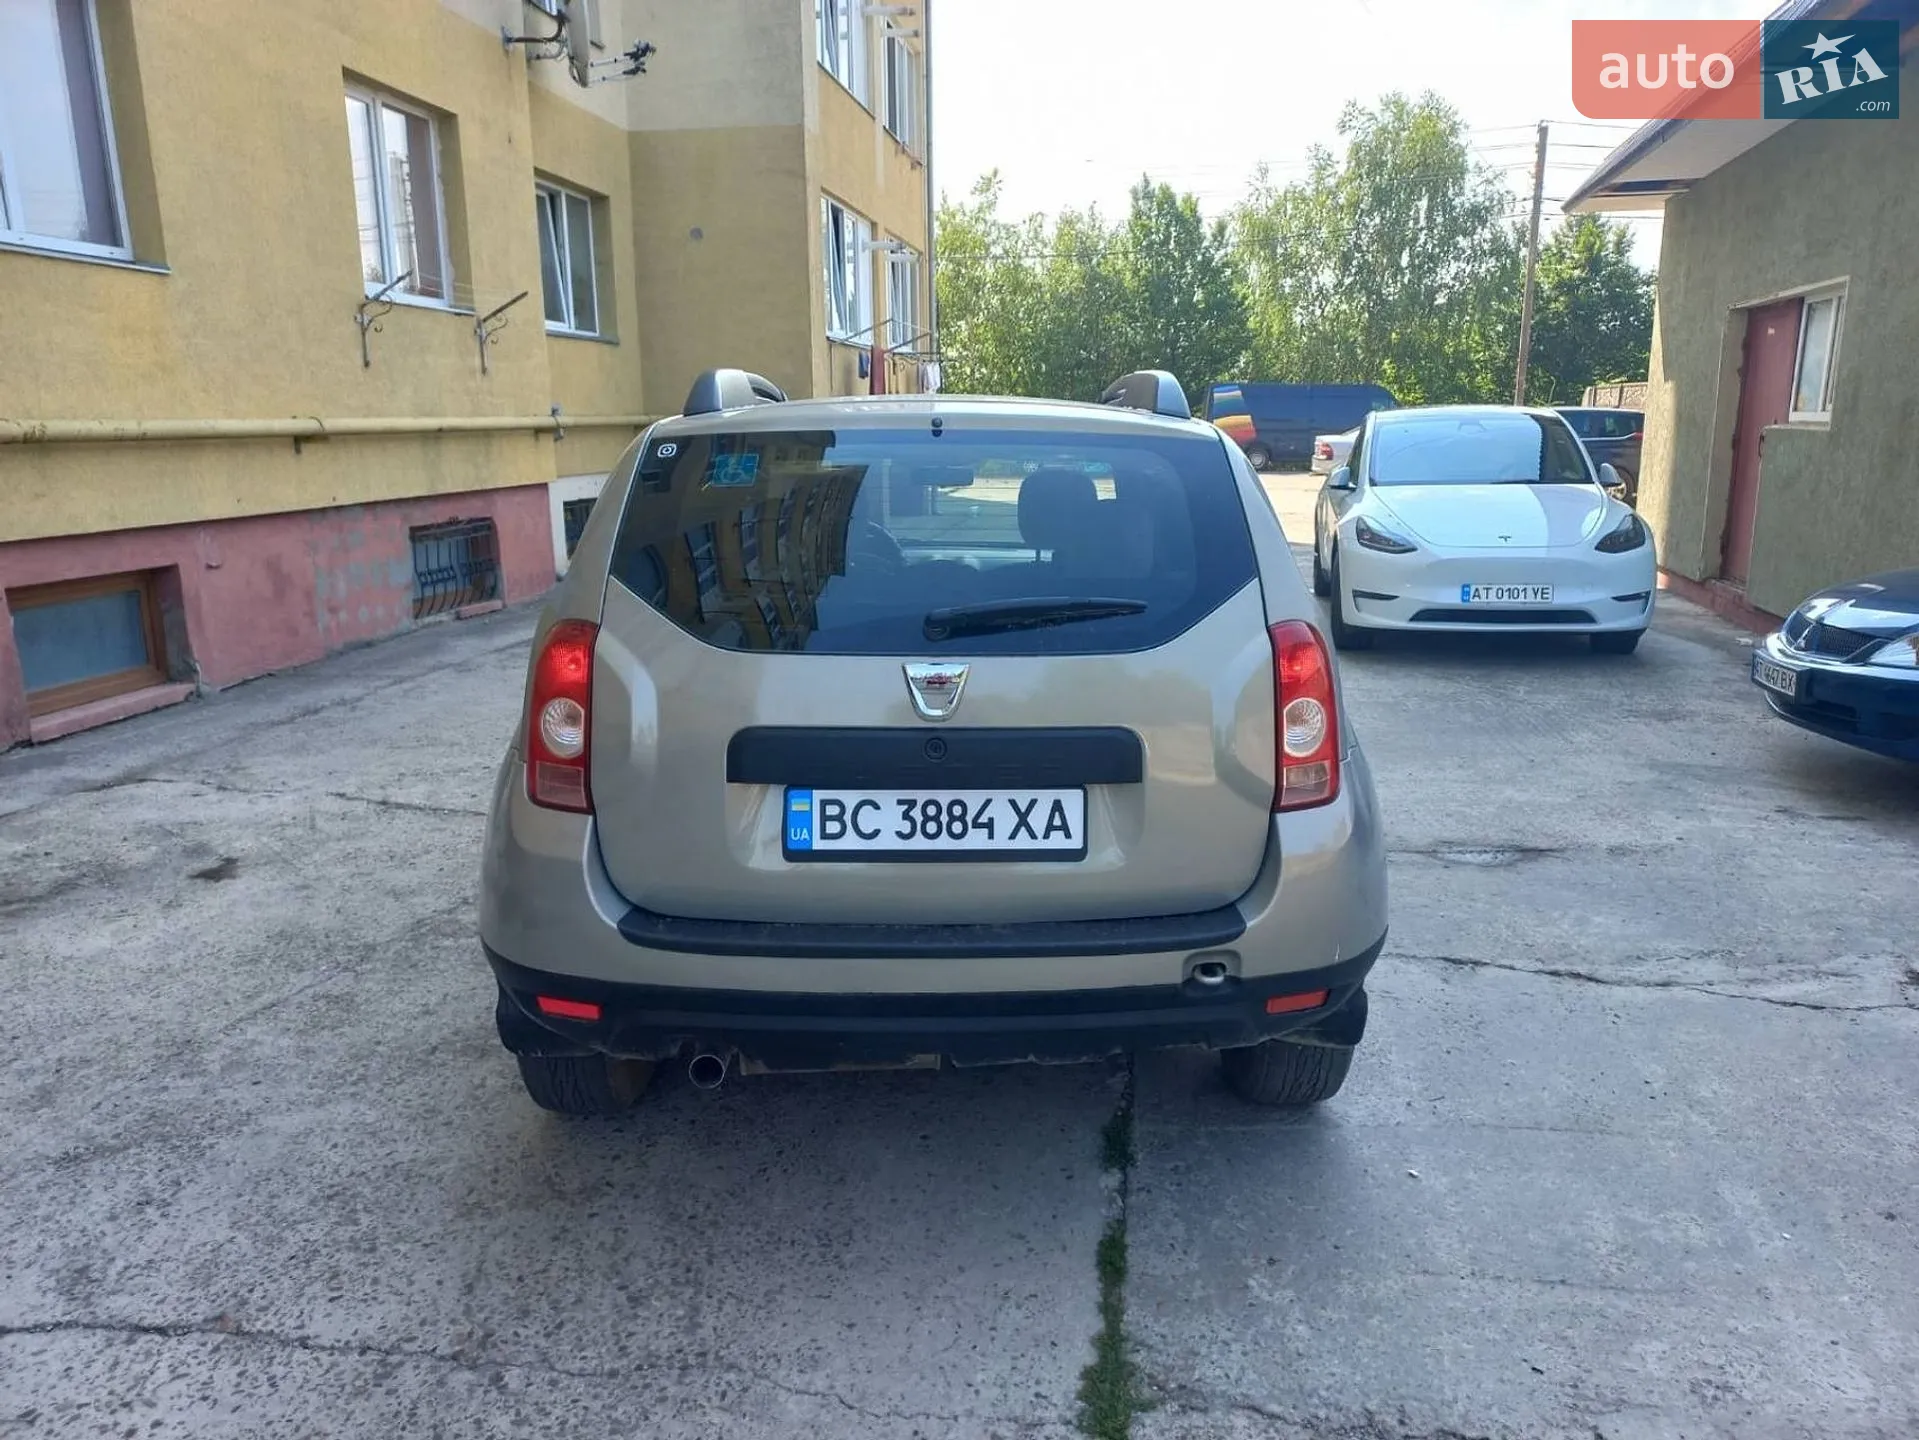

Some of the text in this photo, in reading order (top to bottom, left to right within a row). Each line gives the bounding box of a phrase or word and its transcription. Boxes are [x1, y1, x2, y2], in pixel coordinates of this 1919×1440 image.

[1472, 587, 1493, 599] AT
[1496, 587, 1528, 599] 0101
[1532, 587, 1550, 599] YE
[819, 798, 1072, 840] BC 3884 XA
[791, 827, 811, 841] UA
